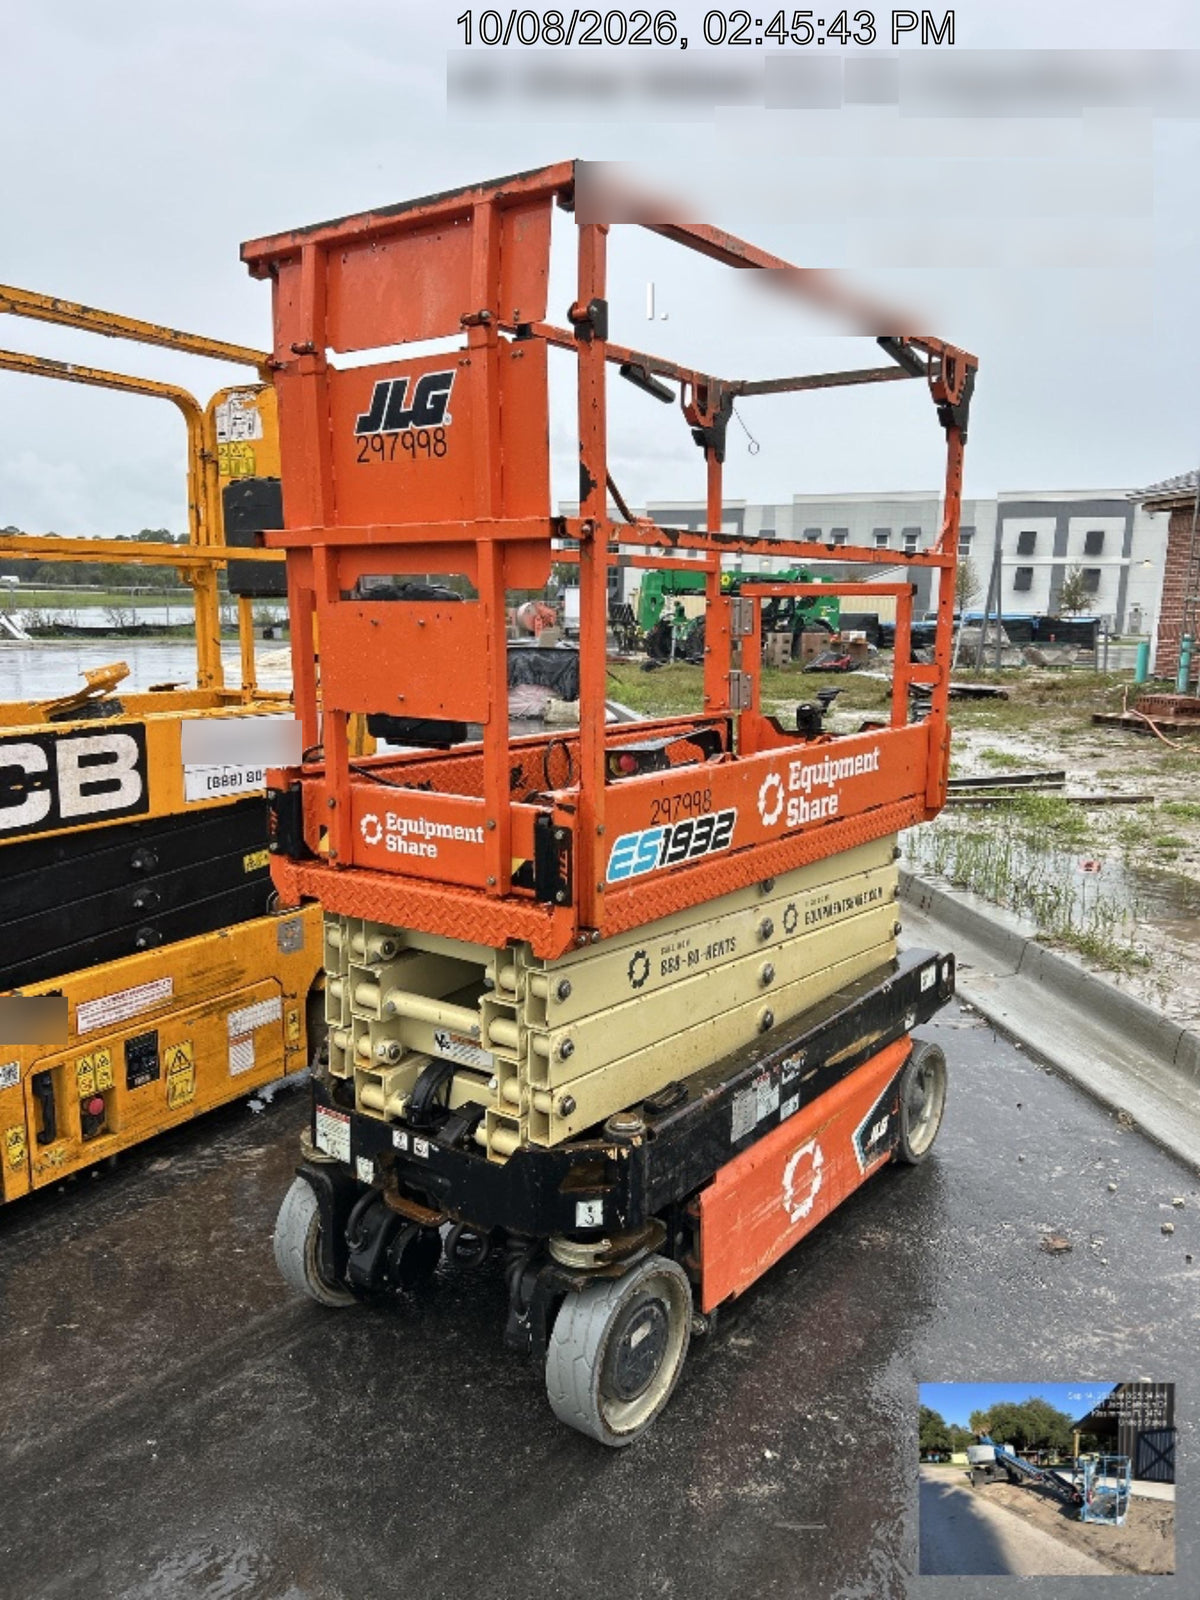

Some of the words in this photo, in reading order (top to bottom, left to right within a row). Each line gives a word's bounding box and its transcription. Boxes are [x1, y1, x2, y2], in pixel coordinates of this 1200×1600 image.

[353, 368, 457, 436] JLG
[356, 427, 448, 463] 297998
[788, 746, 880, 794] Equipment
[650, 788, 712, 826] 297998
[785, 794, 839, 828] Share
[385, 811, 485, 844] Equipment
[385, 833, 438, 858] Share
[606, 807, 737, 884] ES1932
